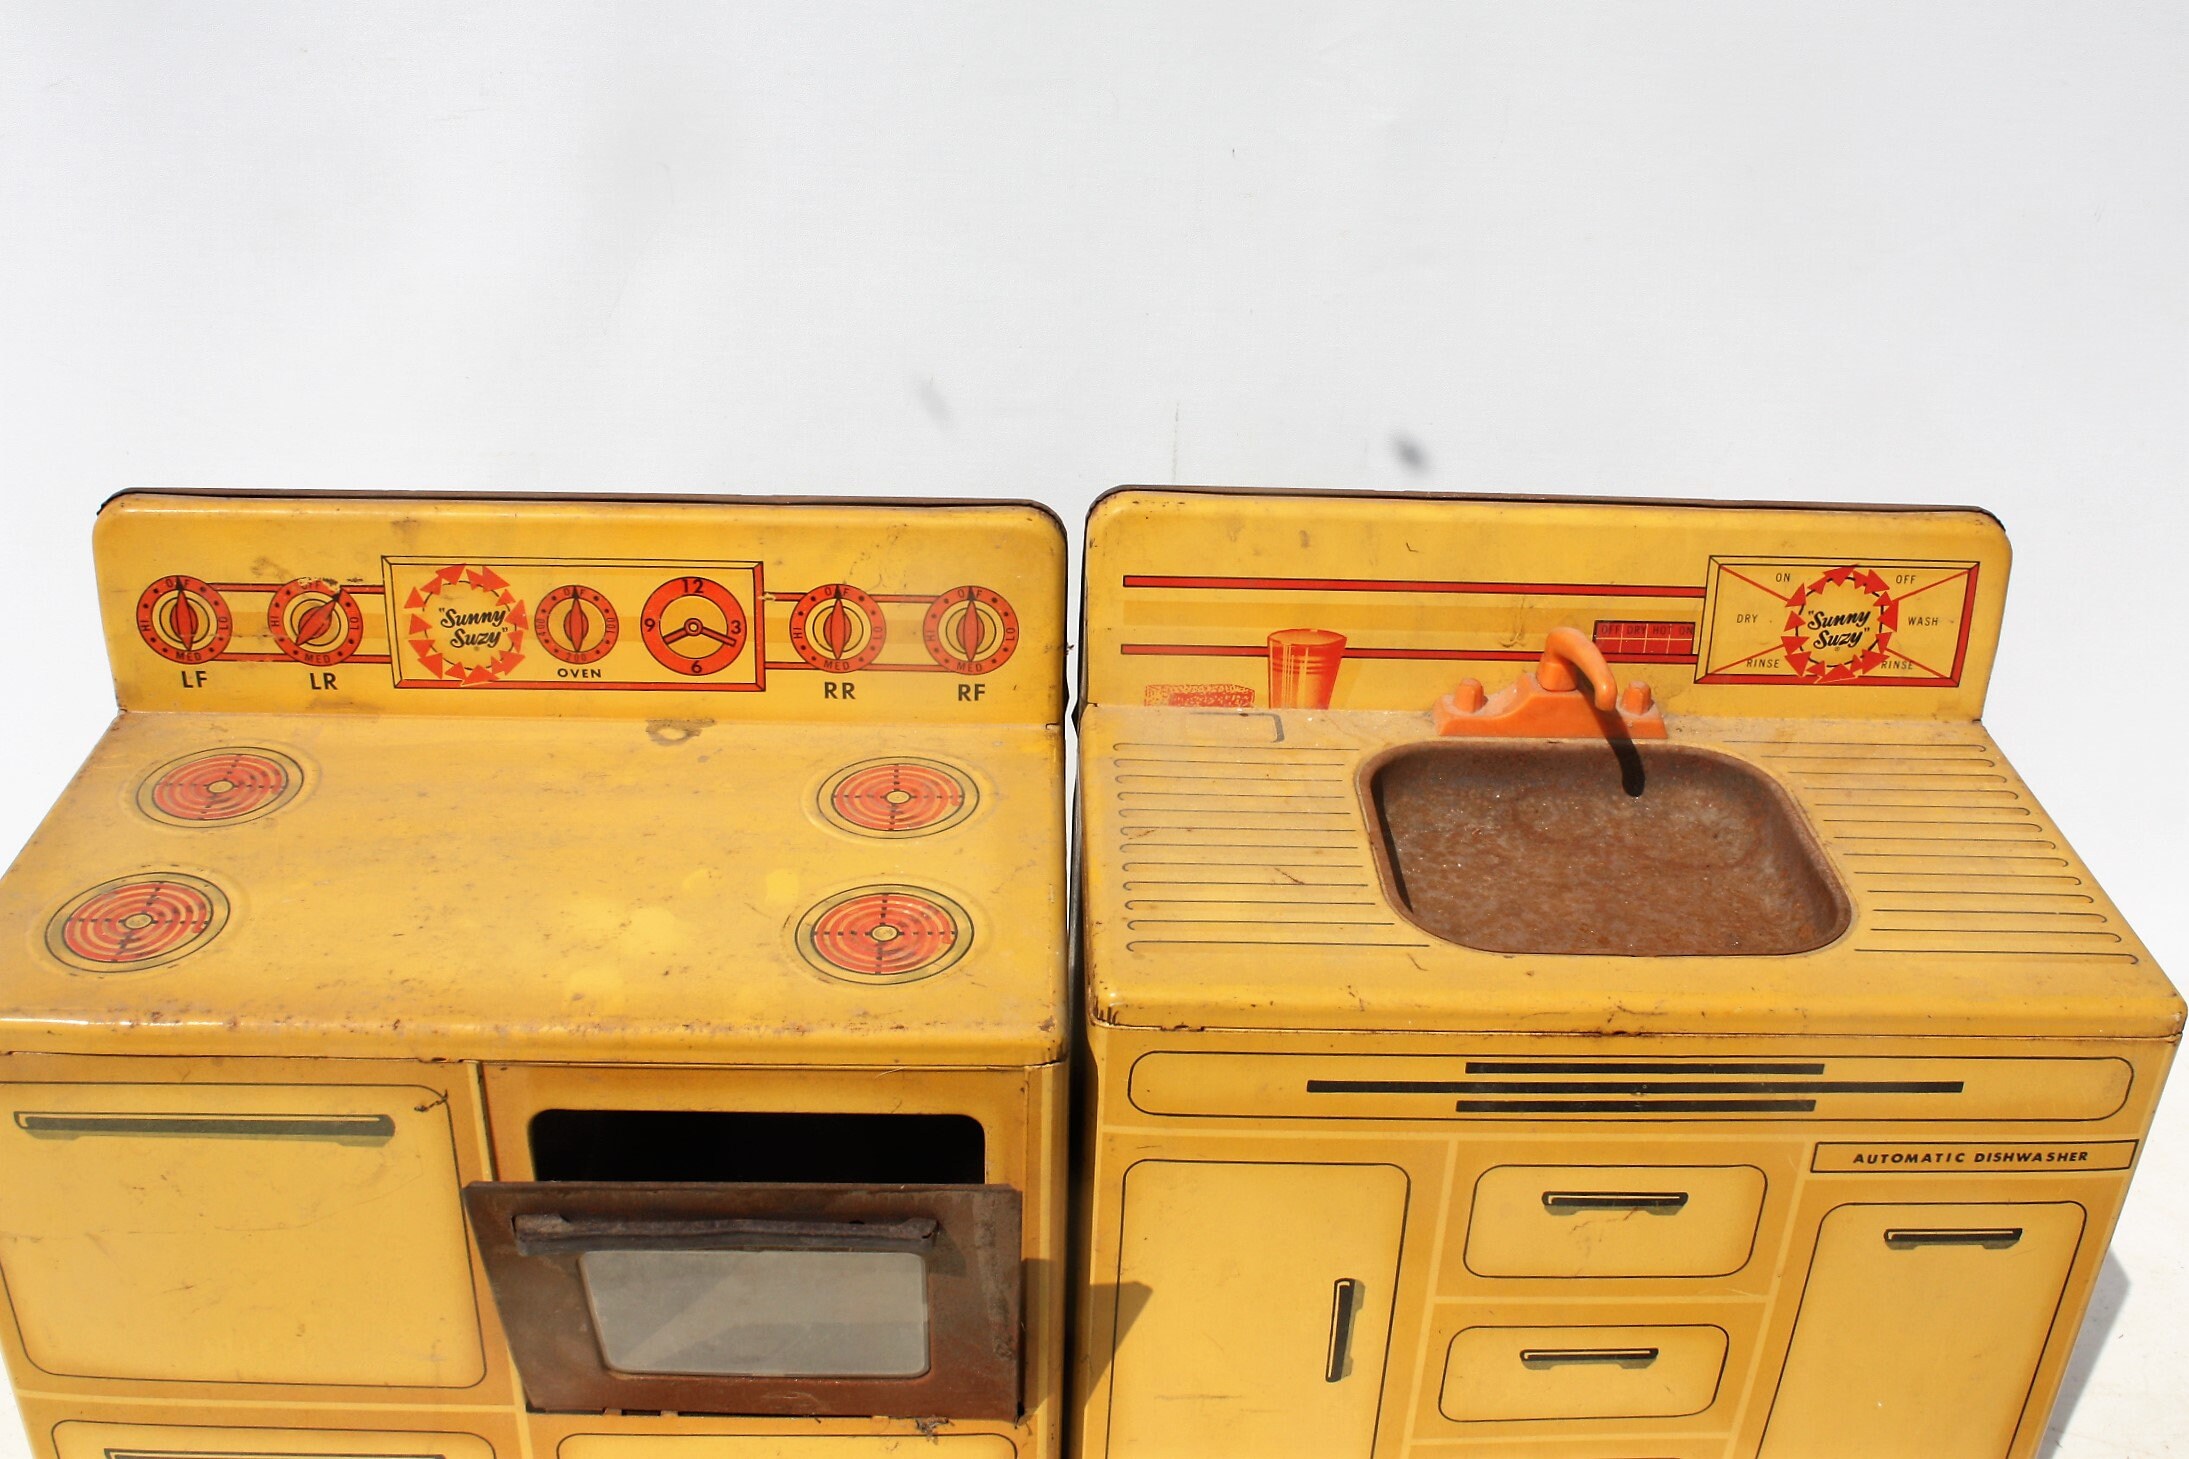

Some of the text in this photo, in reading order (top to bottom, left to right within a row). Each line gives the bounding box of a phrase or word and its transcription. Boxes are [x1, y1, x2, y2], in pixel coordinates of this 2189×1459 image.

[165, 578, 190, 588] OF
[1776, 573, 1791, 583] ON
[1896, 575, 1917, 585] OFF
[681, 579, 704, 594] 12
[824, 587, 850, 597] OF
[957, 589, 983, 599] OF
[644, 617, 656, 633] 9
[1736, 614, 1758, 624] DRY
[1907, 616, 1939, 627] WASH
[730, 619, 742, 635] 3
[175, 651, 202, 662] MED
[304, 654, 332, 665] MED
[690, 659, 703, 674] 6
[823, 660, 850, 671] MED
[956, 662, 983, 673] MED
[1746, 658, 1780, 670] RINSE
[1881, 659, 1914, 671] RINSE
[556, 667, 602, 679] OVEN
[181, 670, 208, 689] LF
[309, 672, 338, 690] LR
[823, 681, 857, 700] RR
[957, 683, 987, 702] RF
[1852, 1150, 2089, 1165] AUTOMATIC DISHWASHER
